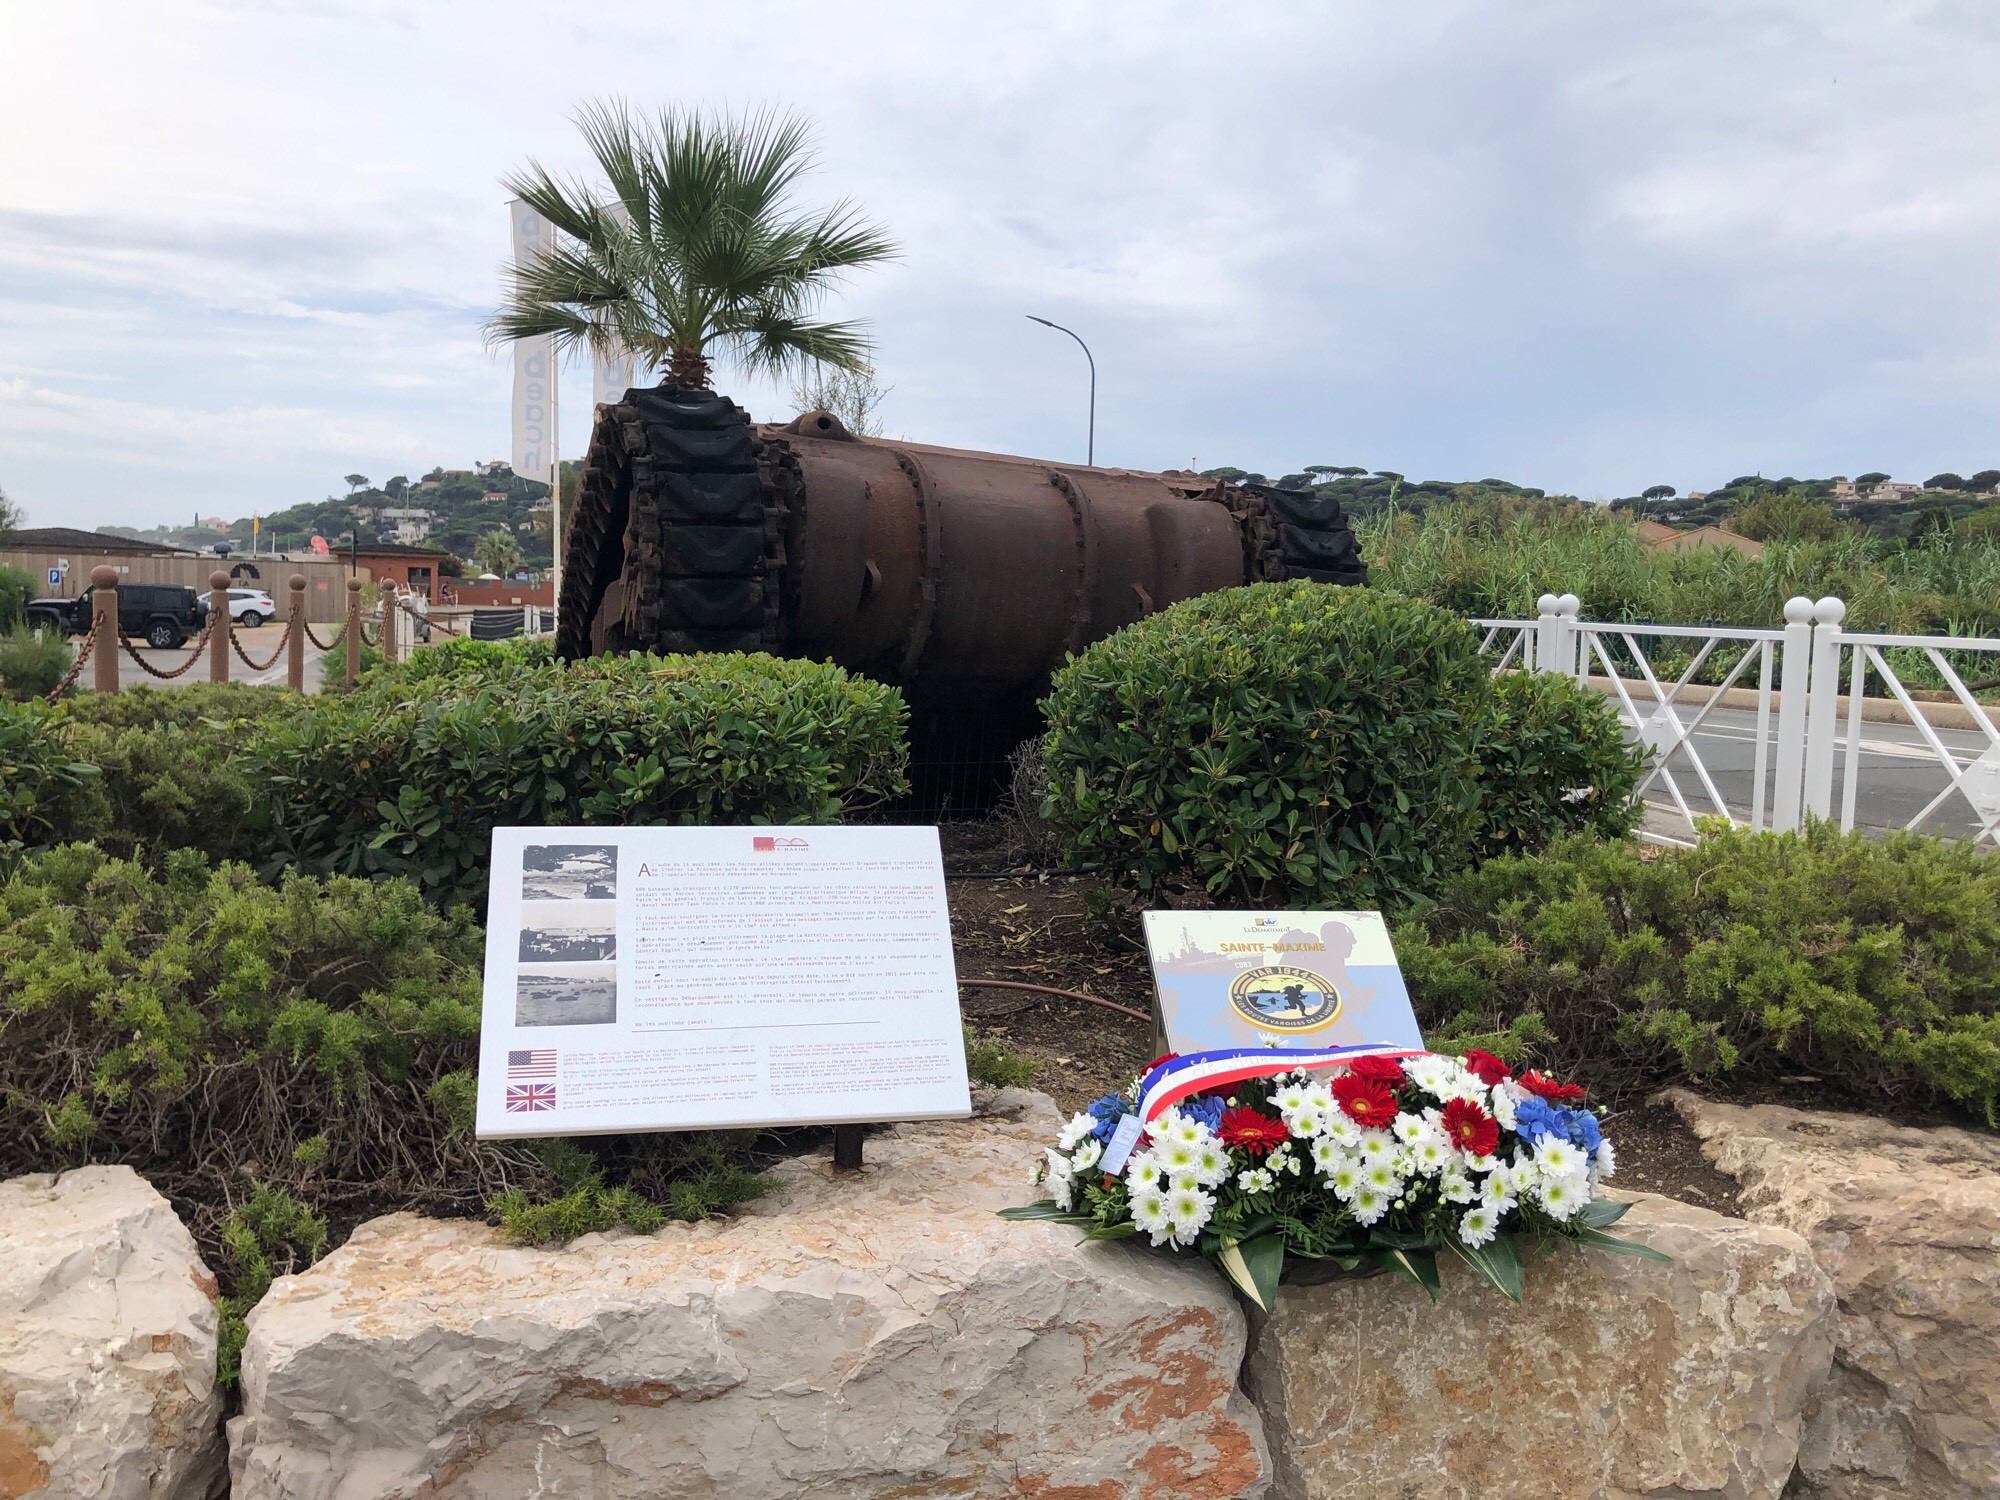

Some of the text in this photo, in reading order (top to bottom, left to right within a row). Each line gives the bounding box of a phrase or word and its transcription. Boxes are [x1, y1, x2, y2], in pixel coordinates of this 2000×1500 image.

[51, 571, 58, 583] P
[638, 862, 651, 878] A
[1219, 942, 1326, 953] SAINTE-MAXIME
[1249, 966, 1310, 980] VAR 1944
[1244, 1006, 1268, 1023] ROUTES
[1306, 1018, 1316, 1026] DE
[1316, 1014, 1325, 1022] LA
